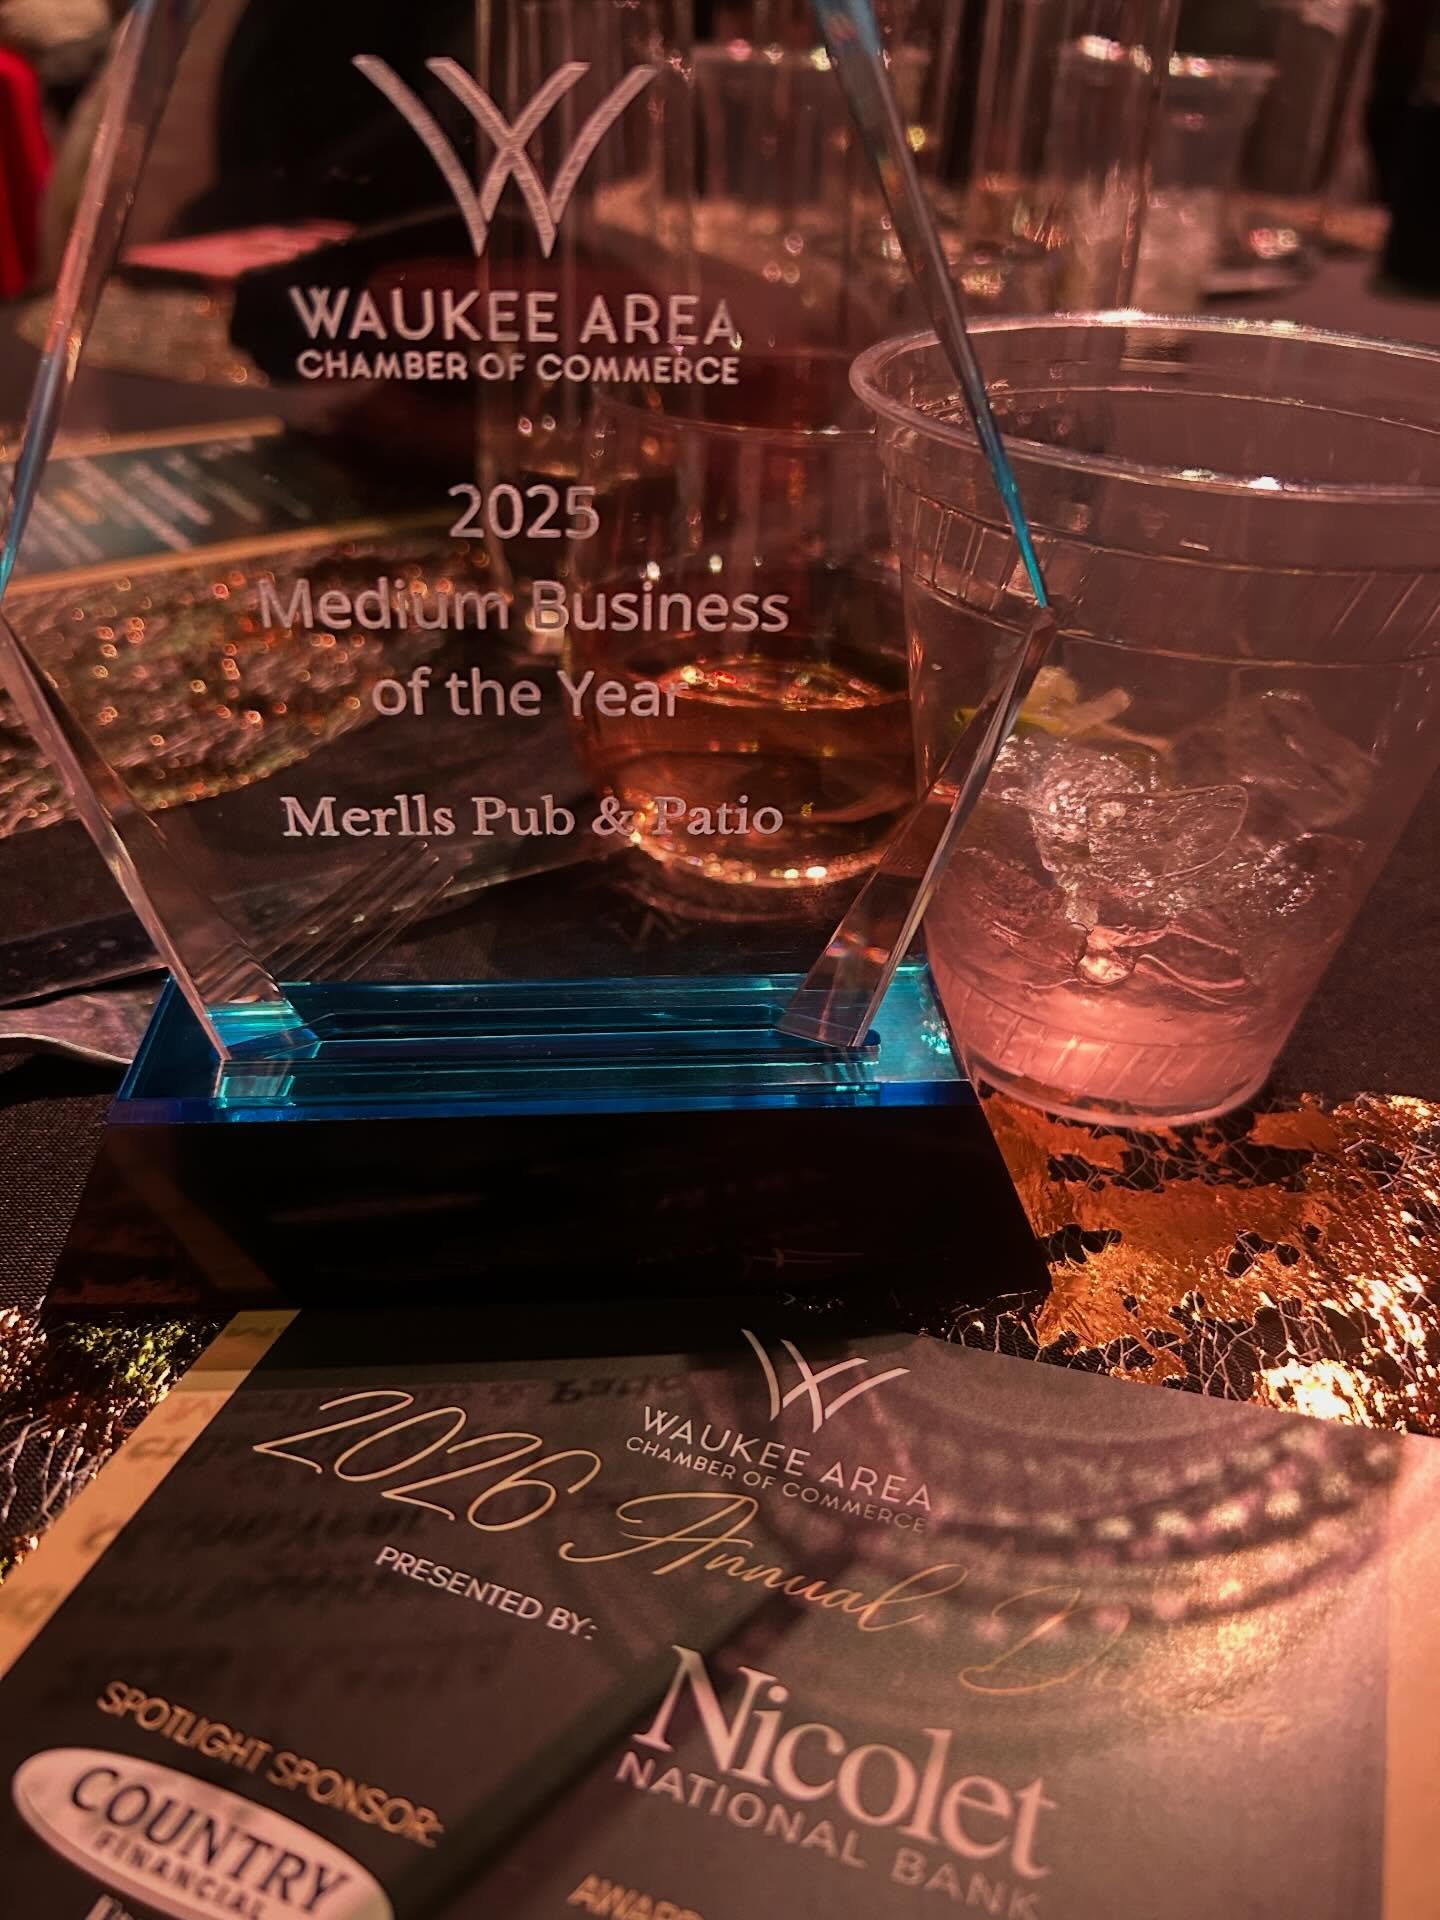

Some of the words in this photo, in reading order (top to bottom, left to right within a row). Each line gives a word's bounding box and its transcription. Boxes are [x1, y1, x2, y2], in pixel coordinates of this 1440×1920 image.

[289, 286, 559, 343] WAUKEE
[580, 293, 737, 345] AREA
[296, 350, 468, 381] CHAMBER
[479, 353, 525, 382] OF
[536, 354, 740, 385] COMMERCE
[448, 483, 600, 539] 2025
[257, 576, 509, 631] Medium
[531, 580, 790, 633] Business
[371, 667, 433, 717] of
[444, 667, 542, 717] the
[557, 670, 688, 718] Year
[280, 794, 457, 838] Merlls
[471, 795, 576, 838] Pub
[591, 795, 634, 838] &
[653, 795, 784, 837] Patio
[625, 1436, 737, 1481] CHAMBER
[742, 1469, 775, 1492] OF
[781, 1481, 928, 1536] COMMERCE
[643, 1406, 812, 1477] WAUKEE
[818, 1465, 933, 1513] AREA
[252, 1390, 602, 1532] 2026
[558, 1491, 969, 1633] Annual
[374, 1545, 544, 1622] PRESENTED
[546, 1606, 599, 1642] BY:
[96, 1680, 274, 1775] SPOTLIGHT
[265, 1751, 446, 1848] SPONSOR
[633, 1644, 1059, 1880] Nicolet
[71, 1766, 350, 1914] COUNTRY
[95, 1830, 267, 1920] FINANCIAL
[614, 1750, 868, 1870] NATIONAL
[890, 1846, 1042, 1920] BANK
